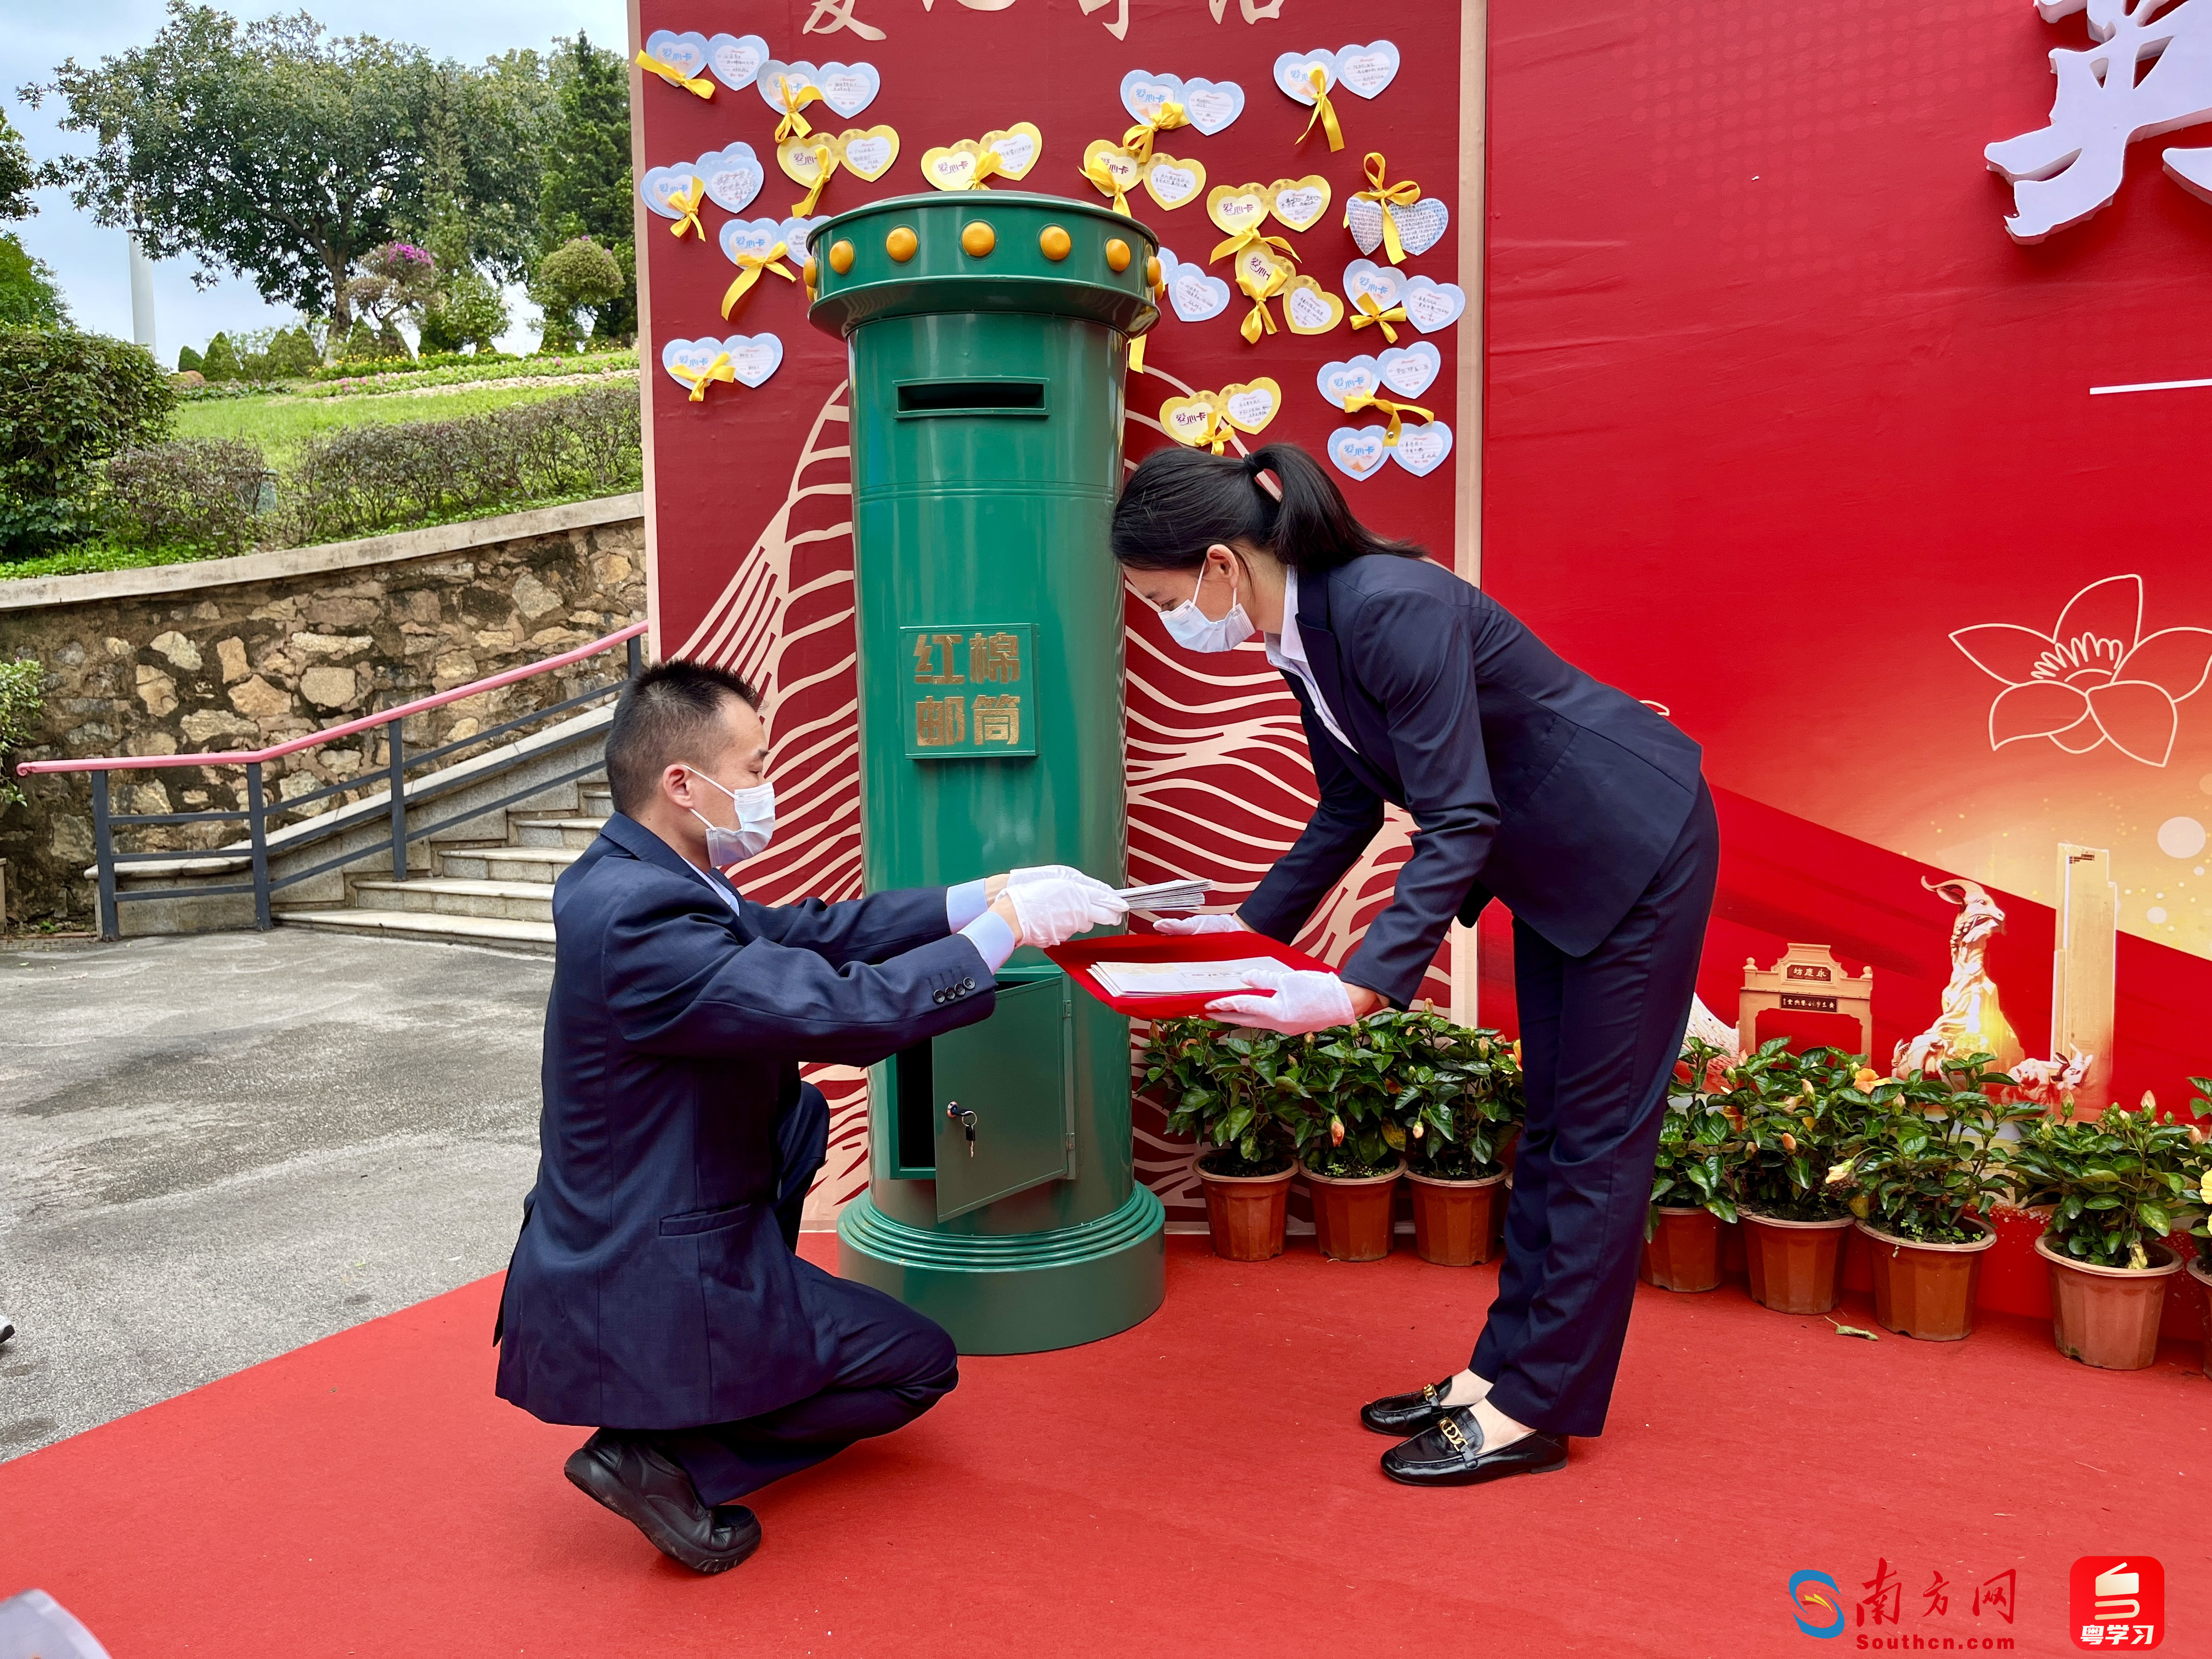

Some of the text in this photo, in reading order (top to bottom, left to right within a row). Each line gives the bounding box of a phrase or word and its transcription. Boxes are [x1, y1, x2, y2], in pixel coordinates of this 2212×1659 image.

[662, 48, 692, 61] 爱心卡
[1291, 70, 1309, 82] 爱心
[1136, 88, 1166, 103] 爱心卡
[794, 153, 817, 164] 爱心
[938, 161, 968, 173] 爱心卡
[1223, 202, 1254, 215] 爱心卡
[736, 236, 765, 248] 爱心卡
[1359, 276, 1388, 295] 爱心卡
[679, 355, 709, 367] 爱心卡
[1334, 376, 1364, 390] 爱心卡
[1176, 412, 1206, 425] 爱心卡
[1345, 444, 1374, 456] 爱心卡
[913, 633, 1020, 684] 红棉
[916, 694, 1020, 747] 邮筒
